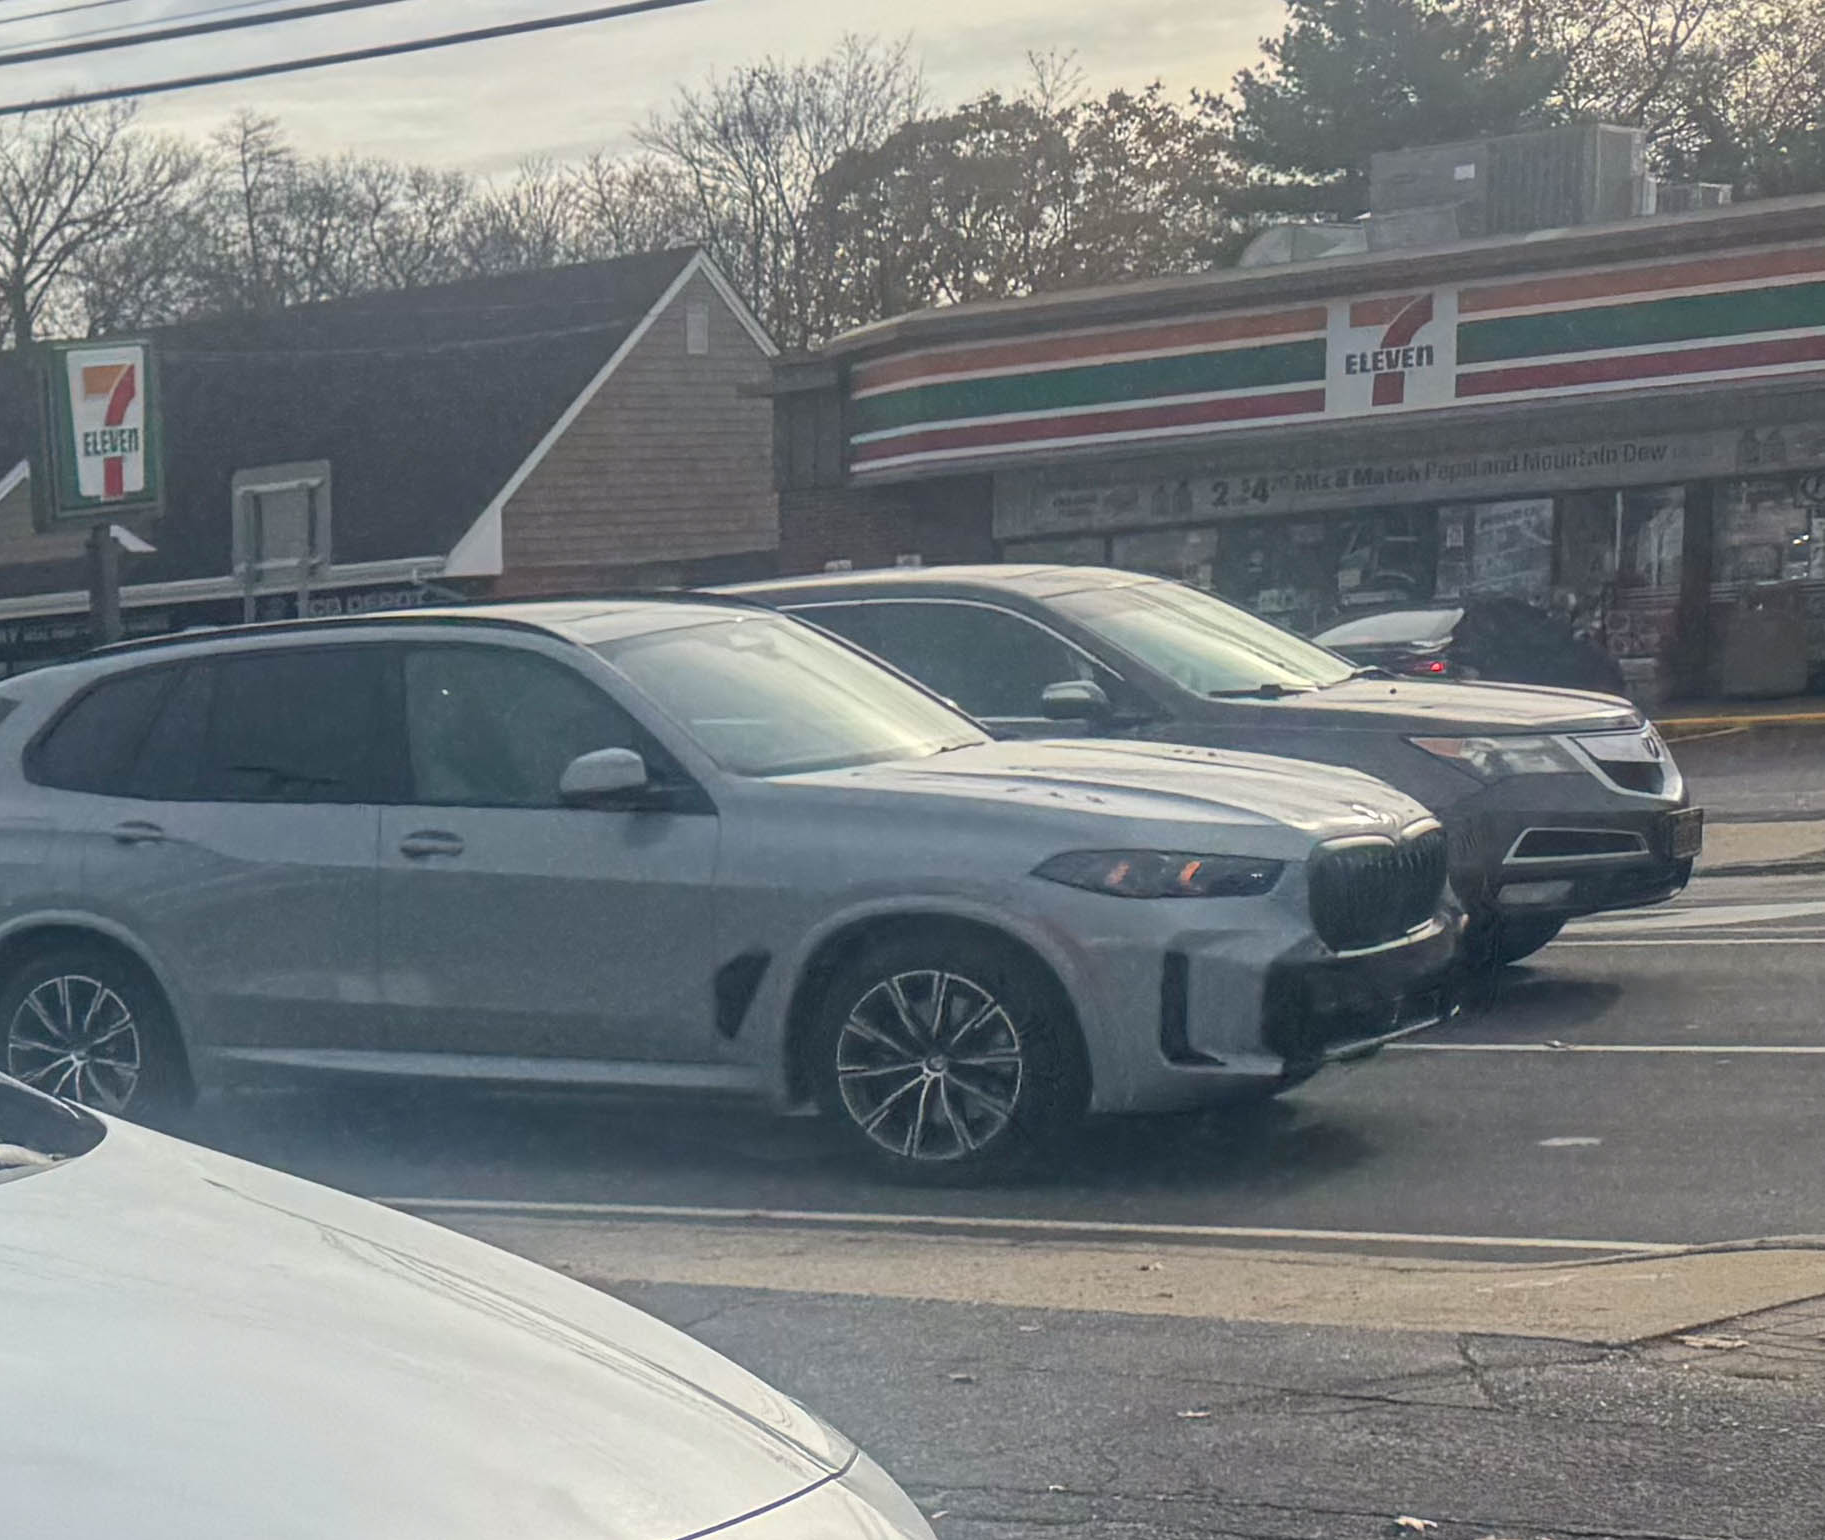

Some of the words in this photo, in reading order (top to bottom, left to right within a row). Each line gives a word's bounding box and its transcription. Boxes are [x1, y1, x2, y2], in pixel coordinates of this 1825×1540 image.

[1349, 293, 1434, 407] 7
[82, 363, 136, 497] 7
[1522, 445, 1619, 473] Mountain
[1622, 443, 1669, 465] Dew
